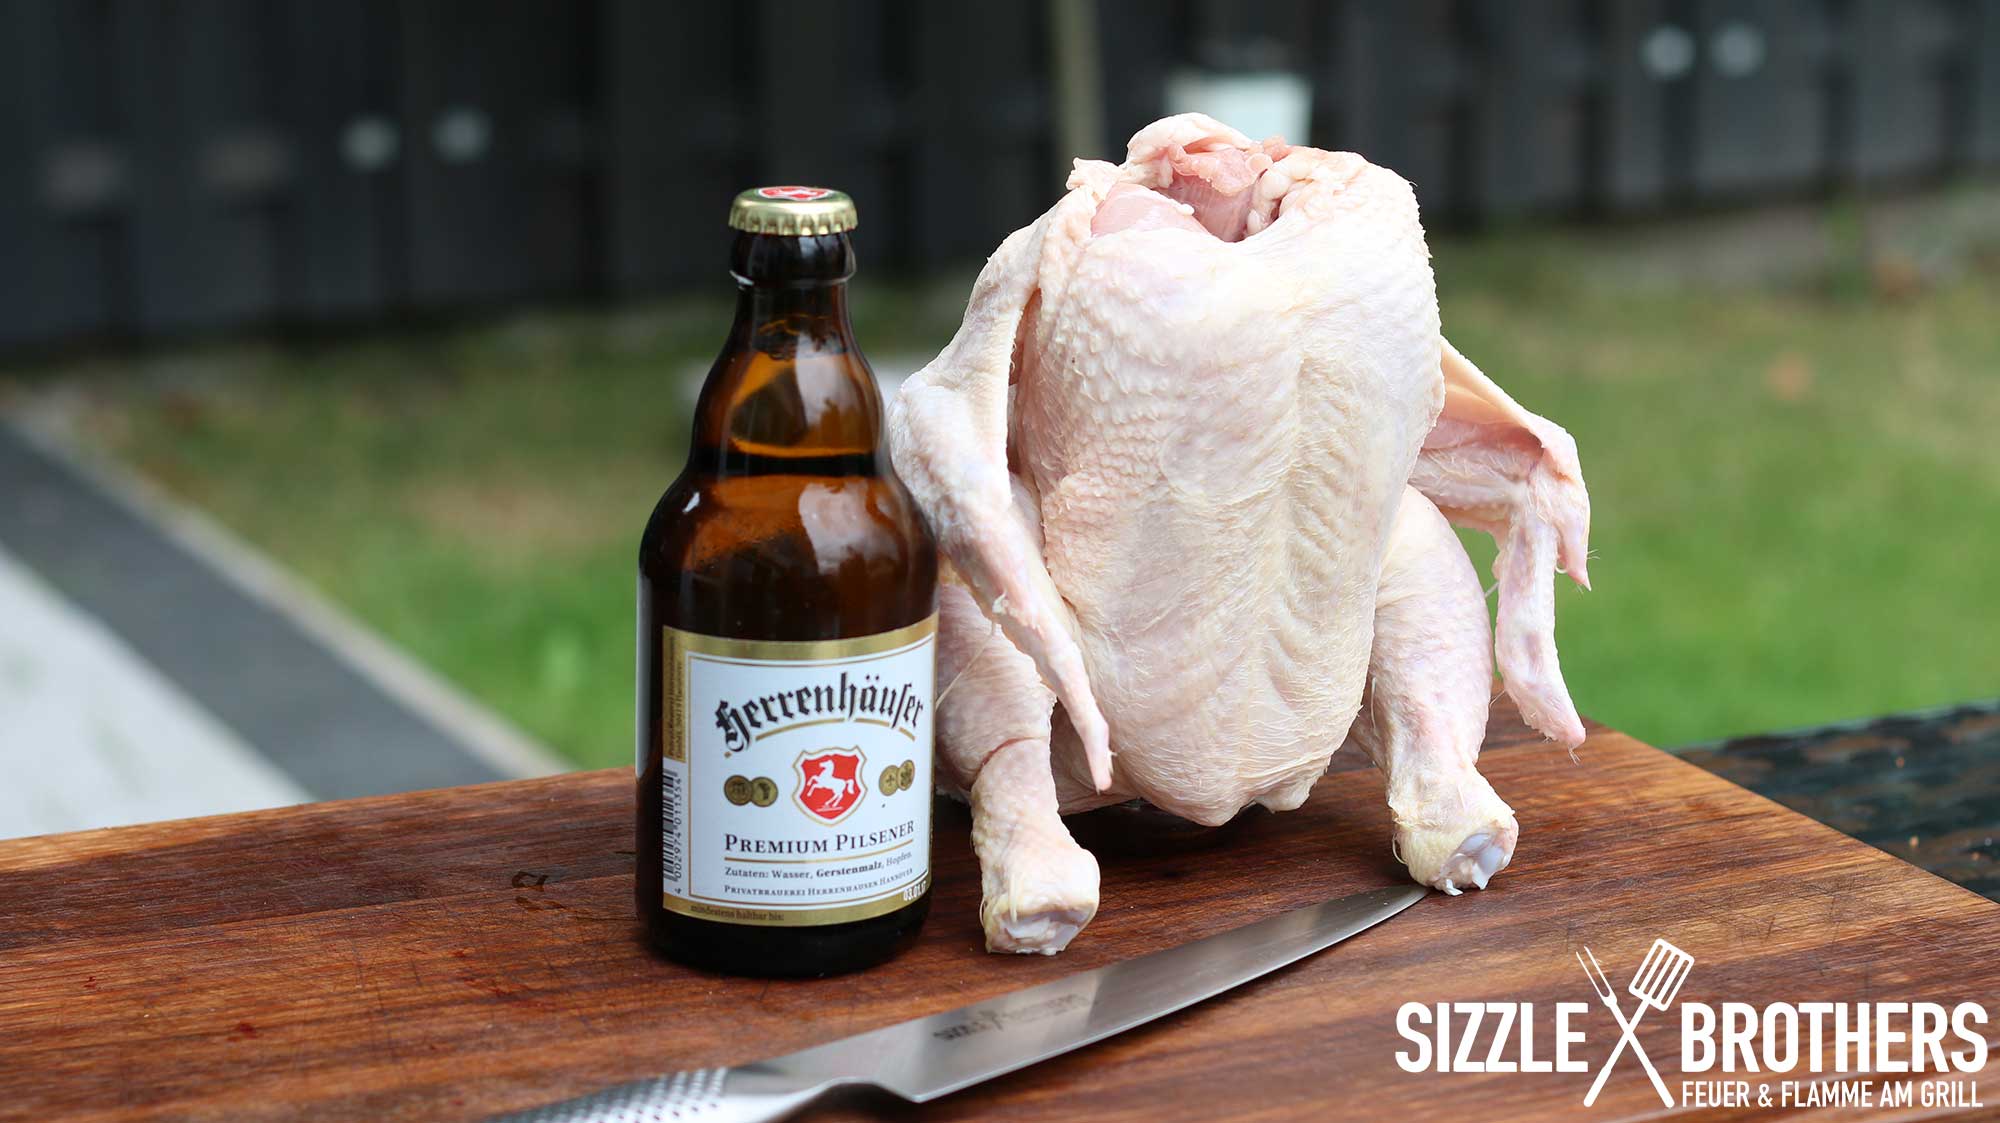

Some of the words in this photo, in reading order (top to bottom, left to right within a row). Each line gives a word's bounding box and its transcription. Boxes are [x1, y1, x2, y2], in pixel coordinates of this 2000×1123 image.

[725, 833, 828, 853] PREMIUM
[836, 820, 914, 851] PILSENER
[725, 867, 769, 878] Zutaten:
[772, 870, 813, 879] Wasser,
[817, 861, 884, 877] Gerstenmalz,
